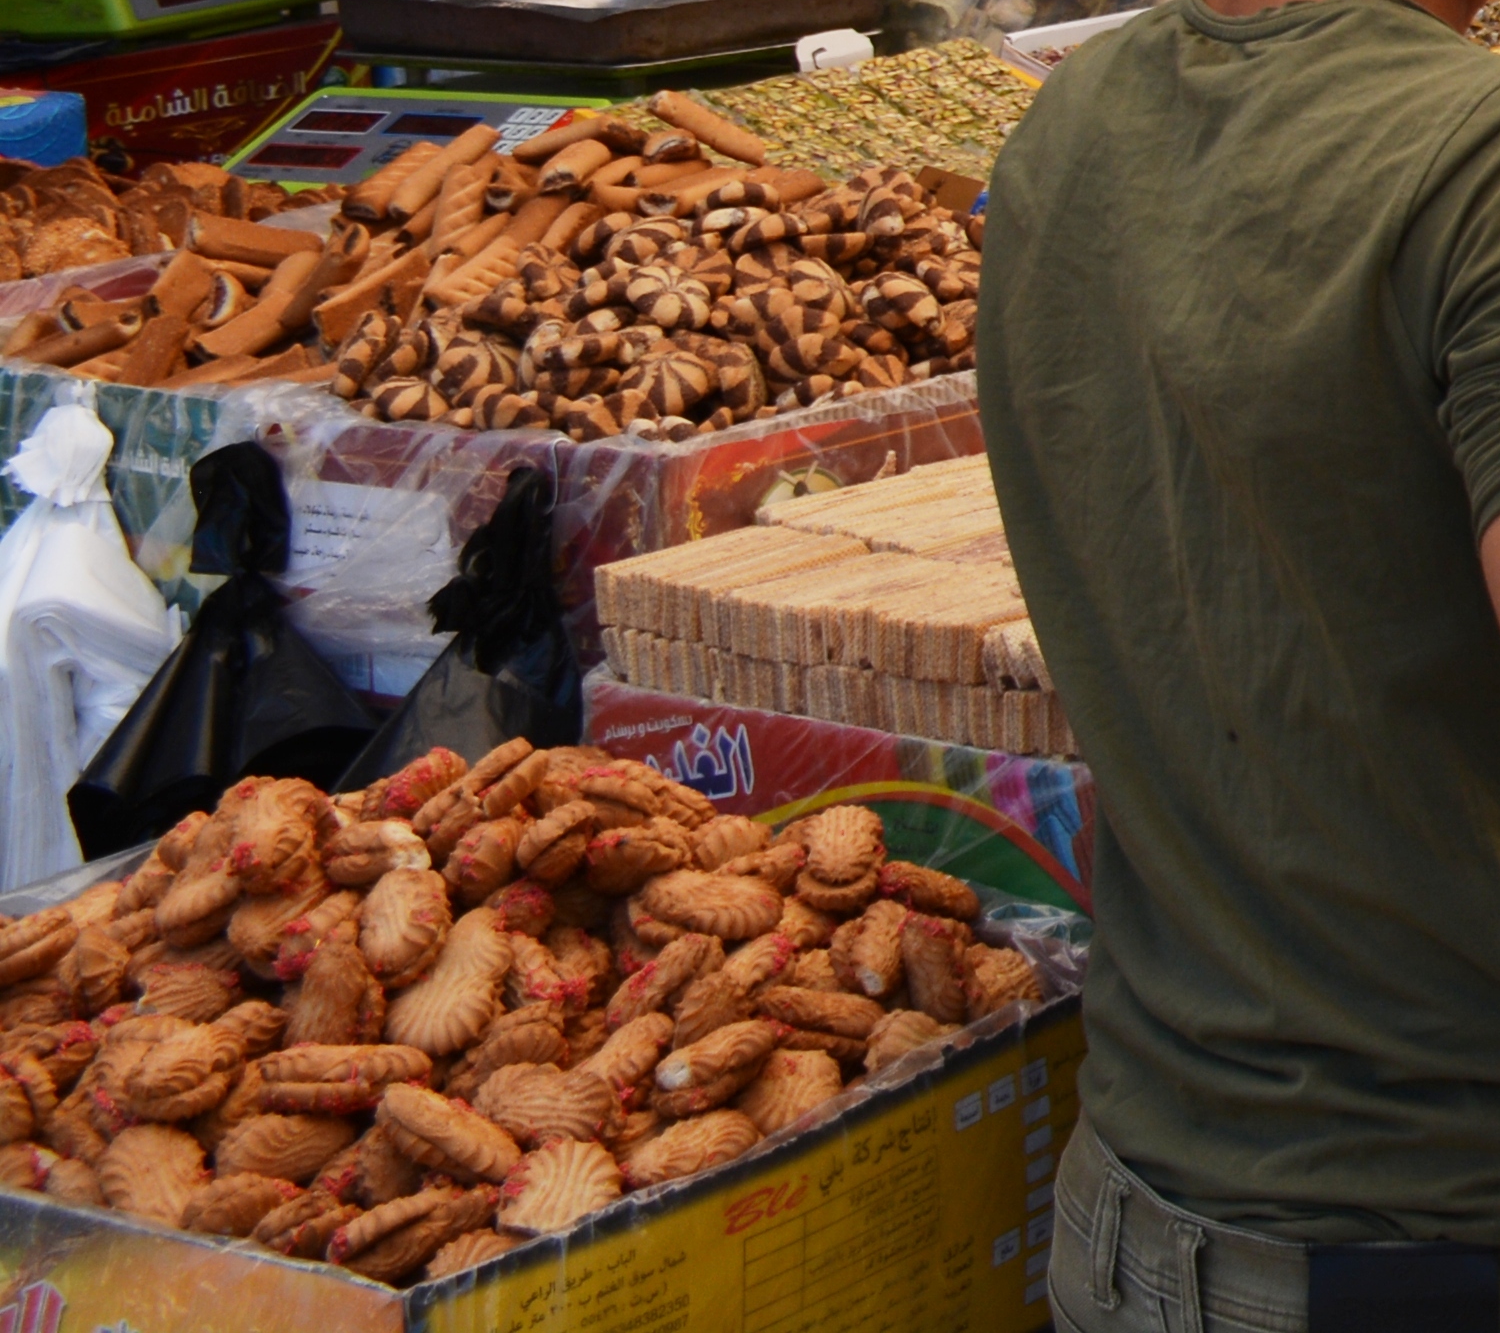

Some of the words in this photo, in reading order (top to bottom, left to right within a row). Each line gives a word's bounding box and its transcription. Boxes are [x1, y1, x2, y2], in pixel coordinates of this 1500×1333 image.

[104, 87, 209, 133] الشامية
[214, 70, 307, 113] الضيافة
[851, 1129, 898, 1168] شركة
